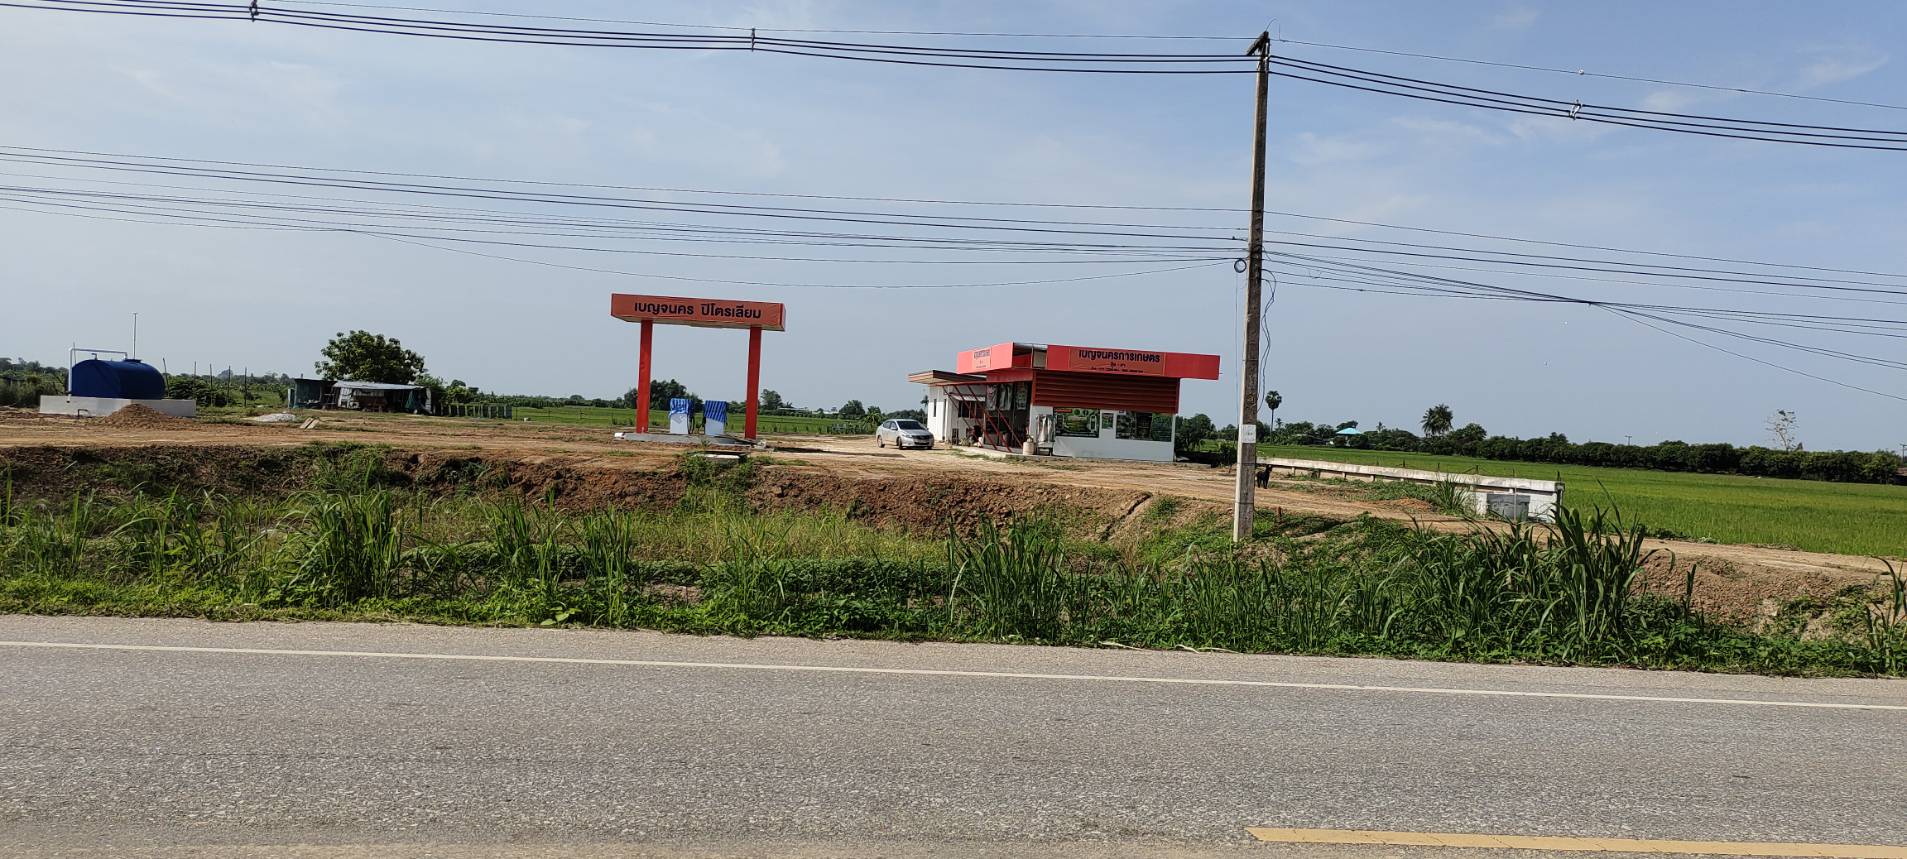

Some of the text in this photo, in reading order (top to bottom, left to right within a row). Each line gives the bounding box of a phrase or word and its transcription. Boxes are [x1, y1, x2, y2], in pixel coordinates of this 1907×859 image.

[634, 302, 761, 319] เบญจนคร ปิโตรเลียม
[1079, 349, 1160, 363] เบญจนครการเกษตร
